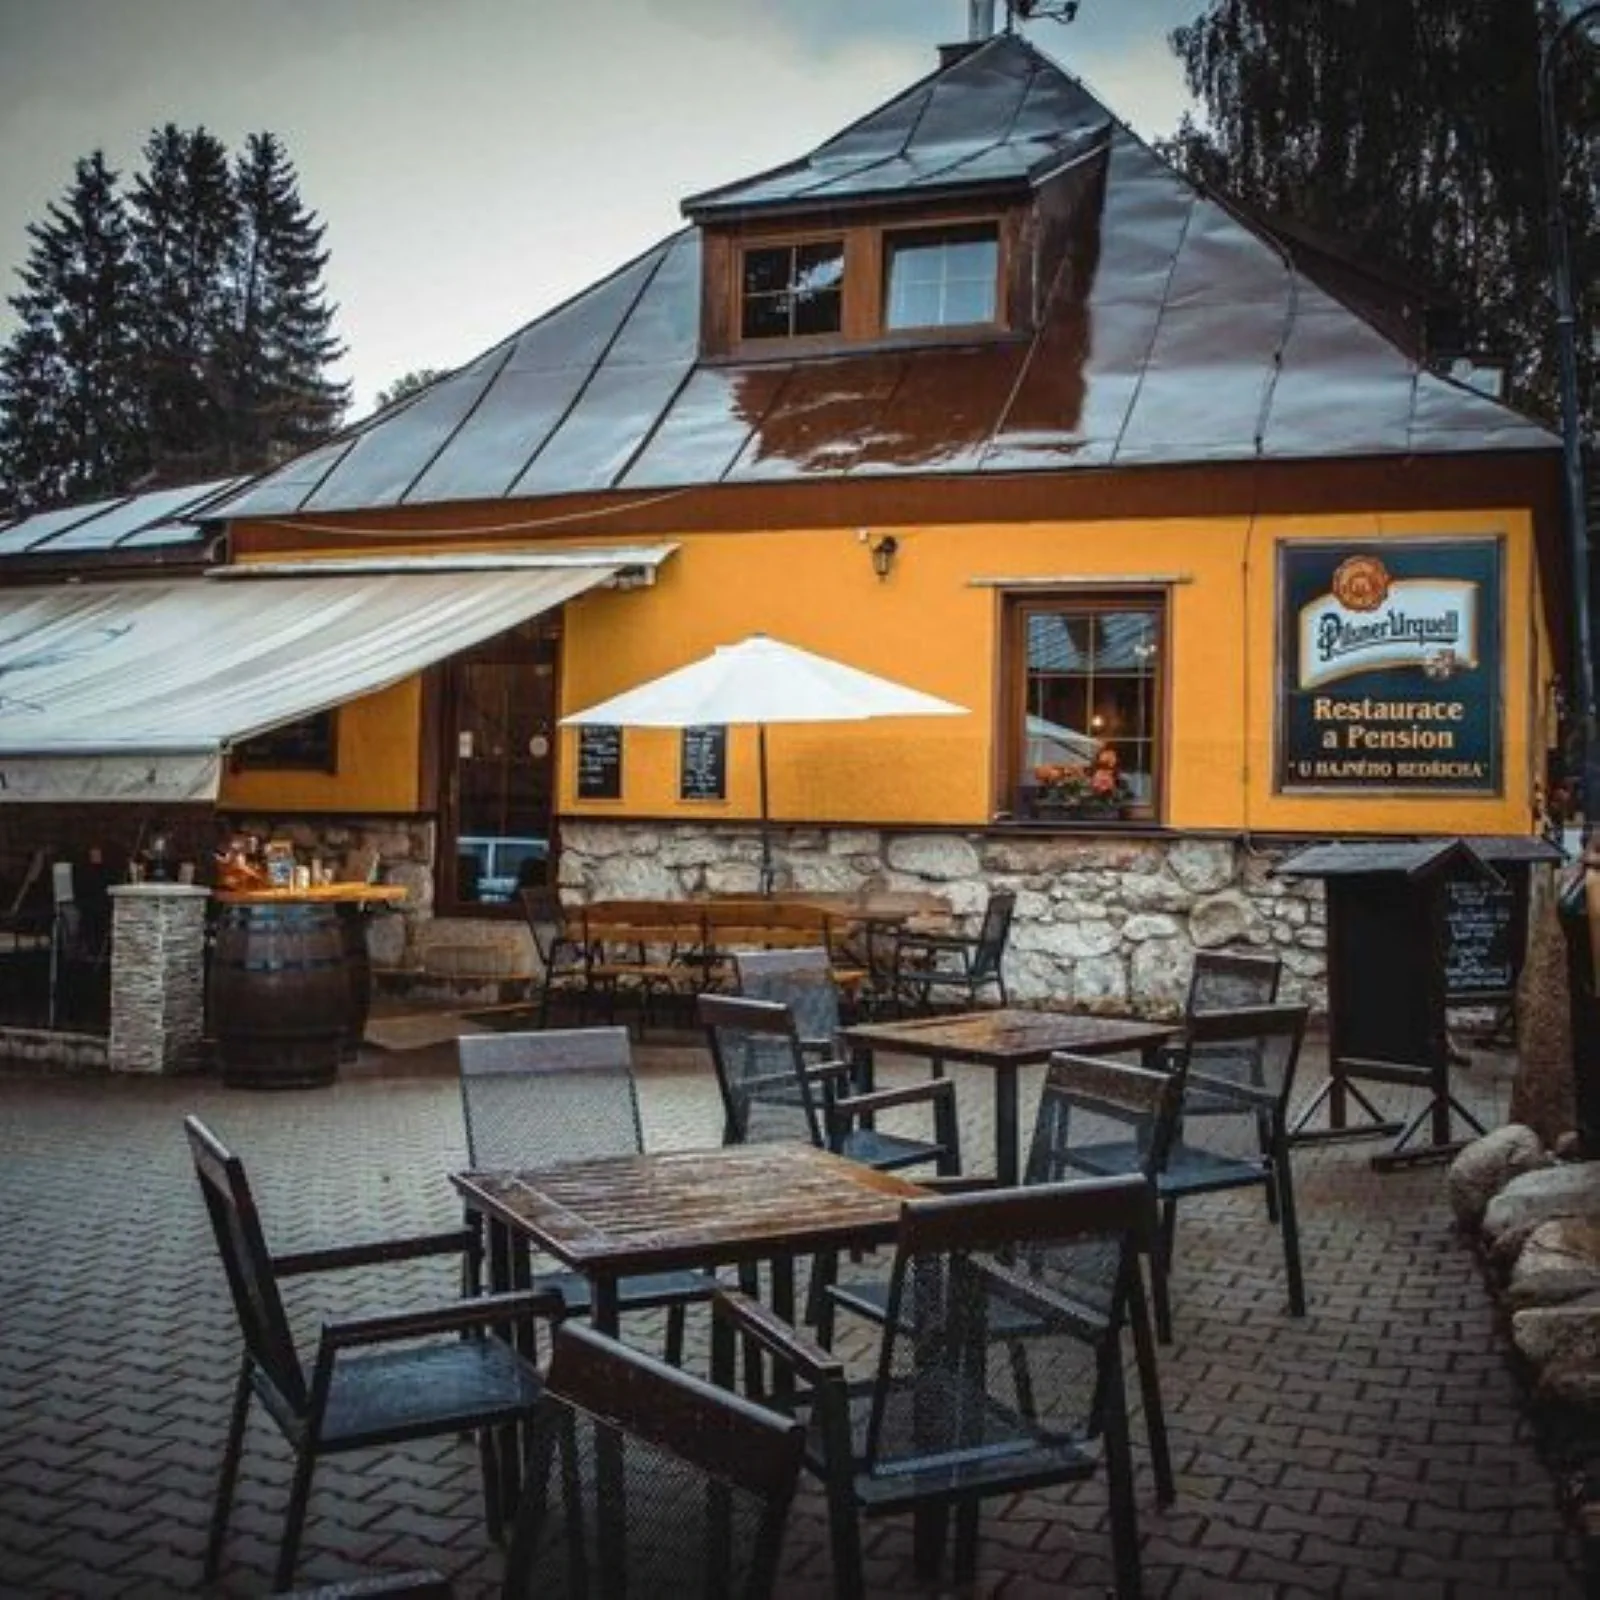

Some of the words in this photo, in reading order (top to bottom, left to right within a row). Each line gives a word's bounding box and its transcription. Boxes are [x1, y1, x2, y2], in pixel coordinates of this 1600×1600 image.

[1318, 612, 1387, 661] Pilsner
[1387, 606, 1459, 646] Urquell
[1314, 698, 1464, 721] Restaurace
[1322, 730, 1338, 749] a
[1348, 724, 1454, 749] Pension
